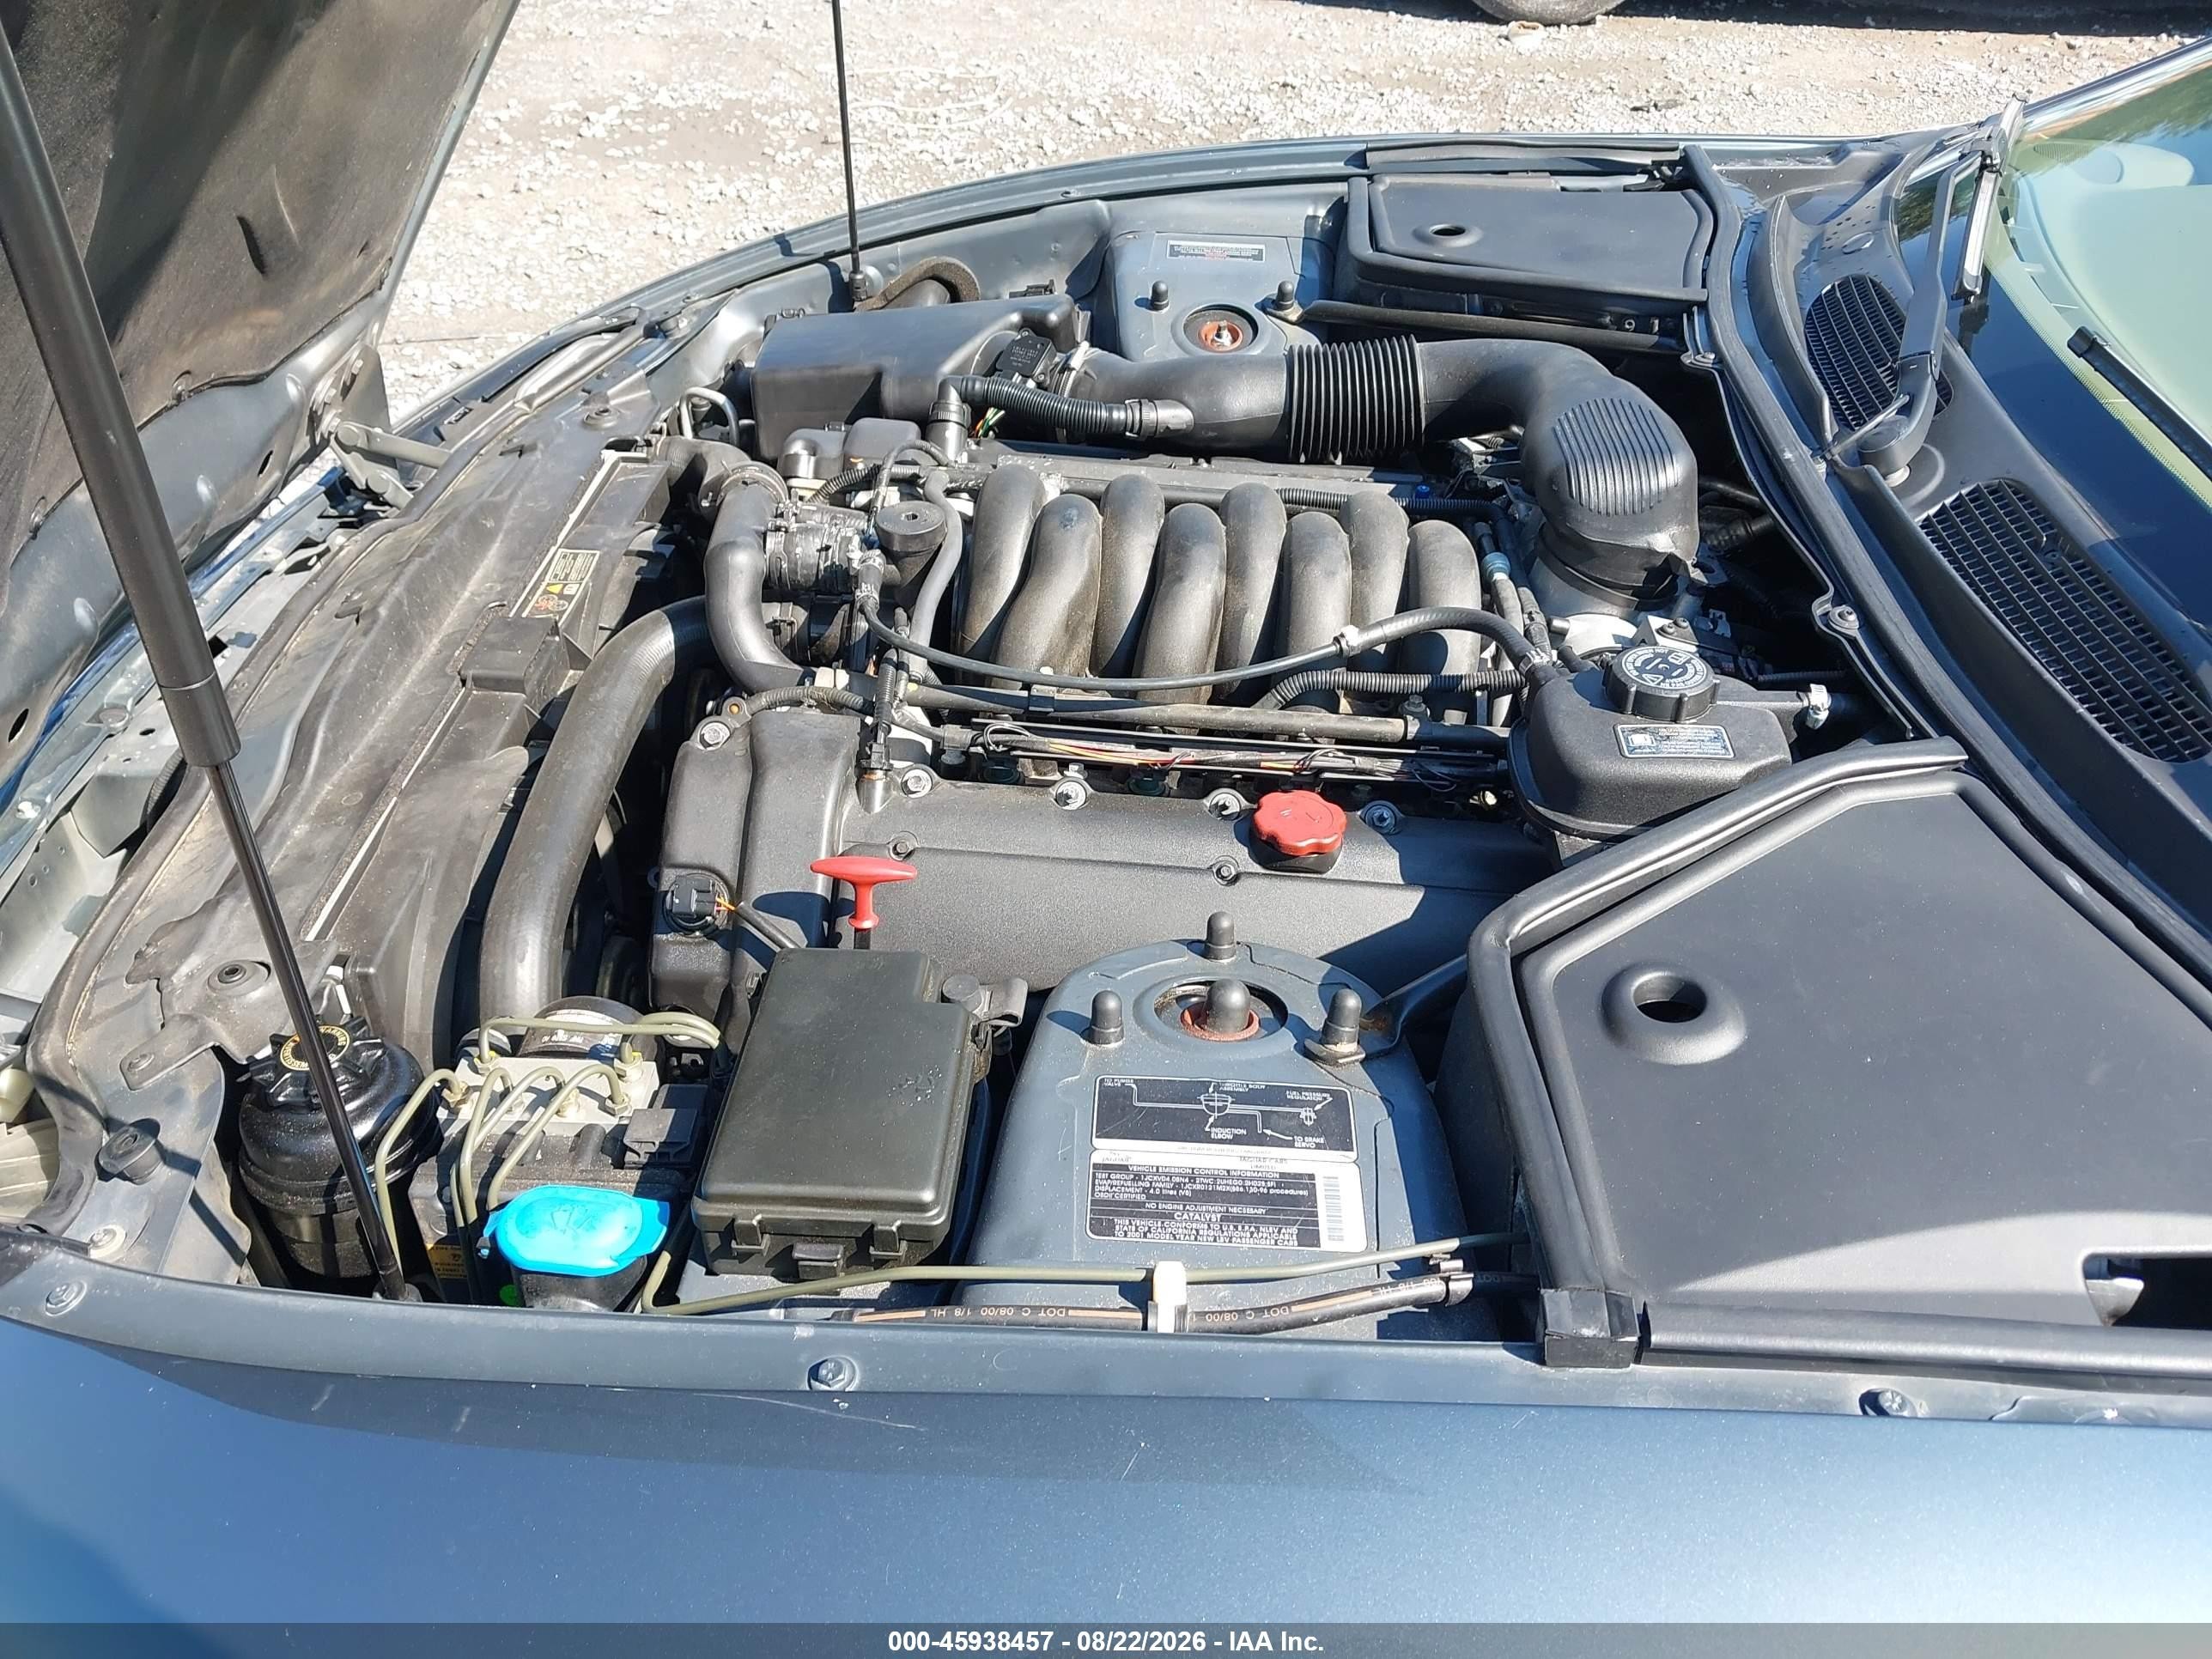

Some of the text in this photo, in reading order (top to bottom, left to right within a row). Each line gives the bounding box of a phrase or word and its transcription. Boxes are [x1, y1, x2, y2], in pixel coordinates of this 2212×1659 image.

[1158, 1166, 1192, 1175] EMISSION
[1194, 1168, 1228, 1176] CONTROL
[1229, 1170, 1279, 1179] INFORMATION
[1095, 1179, 1150, 1188] EVAP/REFUELLING
[1185, 1204, 1226, 1212] ADJUSTMENT
[1228, 1206, 1267, 1215] NECESSARY
[1174, 1212, 1222, 1222] CATALYST
[1164, 1221, 1208, 1230] CONFORMS
[1151, 1226, 1197, 1236] CALIFORNIA
[1199, 1229, 1251, 1237] REGULATIONS
[1253, 1231, 1297, 1241] APPLICABLE
[930, 1307, 1066, 1318] DOT C 08/00 1/8 HL
[1205, 1312, 1238, 1322] 08/00
[1245, 1310, 1255, 1320] C
[1262, 1306, 1290, 1318] DOT
